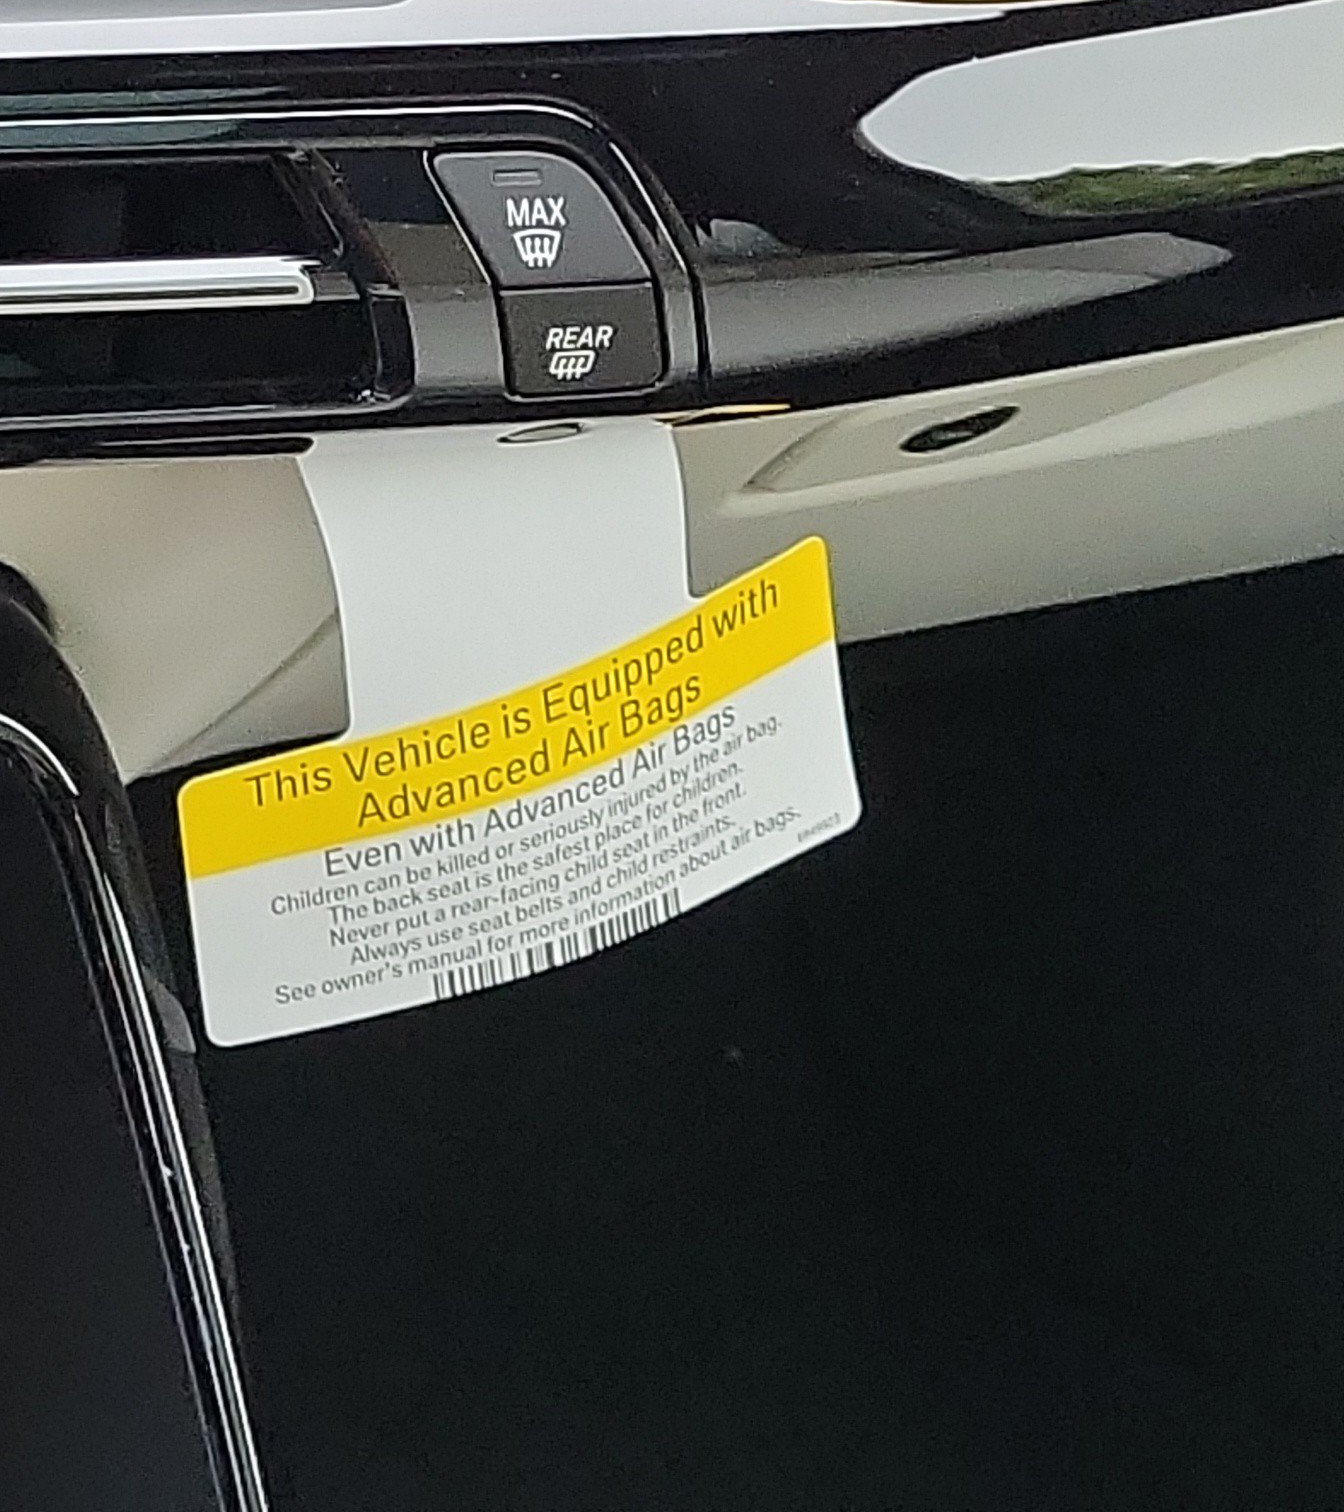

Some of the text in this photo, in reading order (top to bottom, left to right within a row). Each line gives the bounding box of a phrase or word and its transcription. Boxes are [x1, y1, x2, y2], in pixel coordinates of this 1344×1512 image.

[505, 195, 567, 227] MAX
[545, 324, 614, 350] REAR
[243, 579, 778, 807] This Vehicle is Equipped with
[358, 675, 701, 828] Advanced Air Bags
[270, 716, 782, 916] Children can be killed or seriously injured by the air bag.
[324, 705, 735, 877] Even with Advanced Air Bags
[328, 761, 743, 925] The back seat is the safest place for children.
[329, 781, 747, 947] Never put a rear-facing child seat in the front.
[274, 980, 316, 1005] See
[322, 961, 403, 995] owner's
[408, 939, 483, 974] manual
[488, 934, 513, 953] for
[519, 917, 570, 941] more
[574, 867, 676, 926] information
[680, 839, 728, 877] about
[731, 826, 751, 851] air
[753, 806, 802, 838] bags.
[350, 814, 736, 966] Always use seat belts and child restraints.
